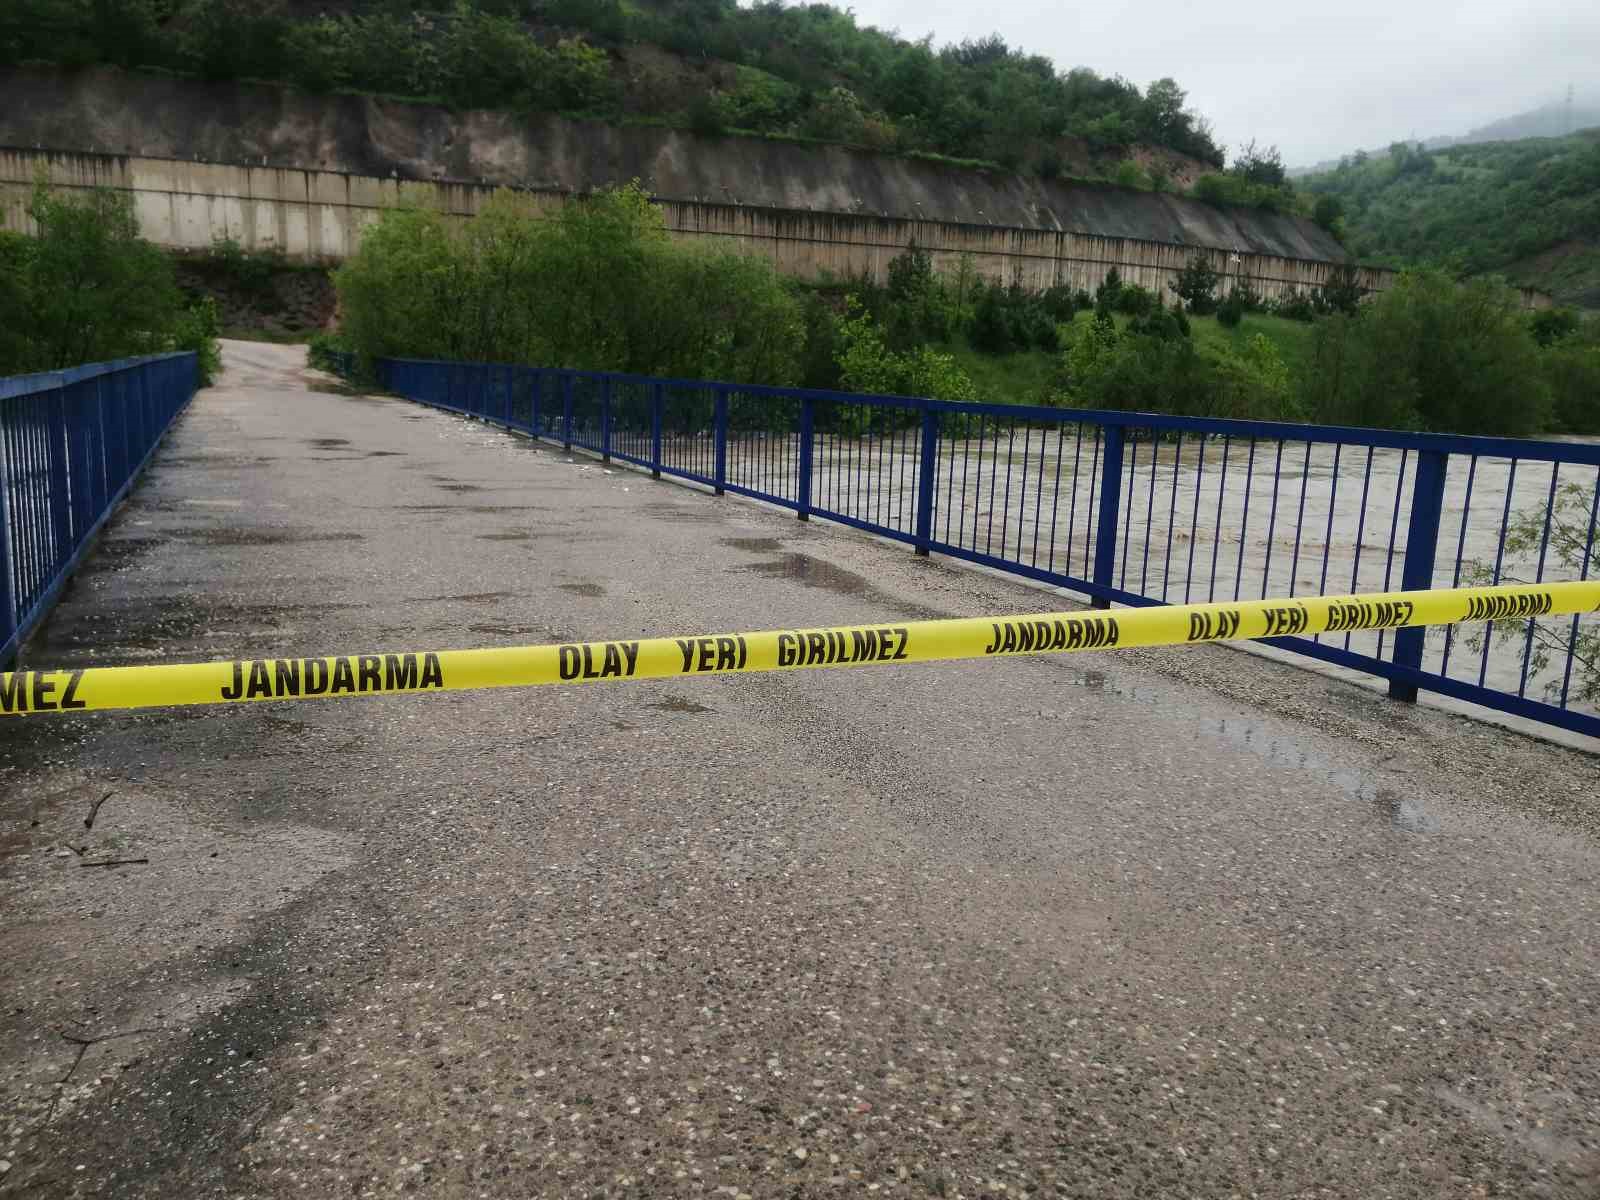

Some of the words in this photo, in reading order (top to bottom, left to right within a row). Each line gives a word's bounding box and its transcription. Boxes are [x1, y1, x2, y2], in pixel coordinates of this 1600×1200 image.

[0, 672, 86, 711] MEZ
[221, 652, 443, 700] JANDARMA
[559, 642, 640, 680] OLAY
[986, 618, 1119, 653] JANDARMA
[1188, 611, 1241, 641] OLAY
[1262, 602, 1309, 636] YERİ
[1324, 599, 1414, 631] GİRİLMEZ
[1460, 593, 1552, 621] JANDARMA
